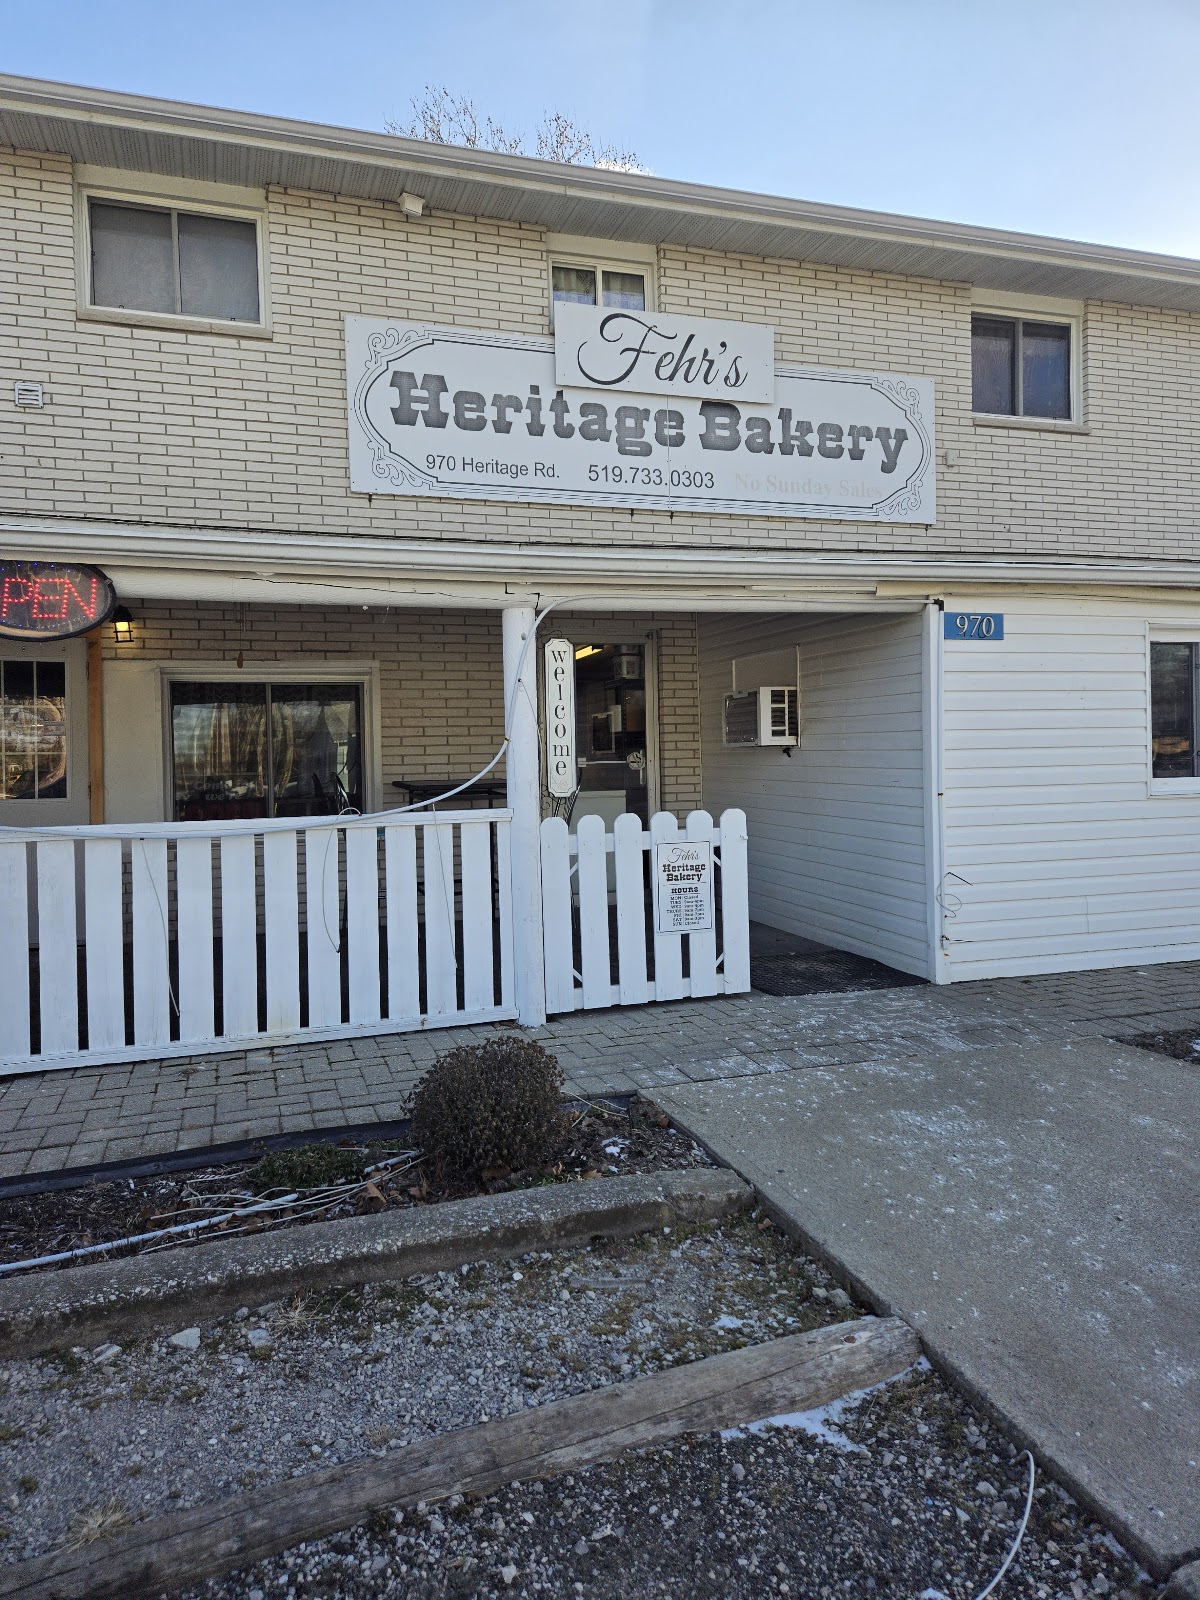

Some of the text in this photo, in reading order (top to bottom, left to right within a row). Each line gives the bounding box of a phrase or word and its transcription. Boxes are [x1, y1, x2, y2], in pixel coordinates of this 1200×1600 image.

[577, 313, 748, 388] Fehr's
[389, 370, 909, 474] Heritage Bakery
[426, 454, 715, 489] 970 Heritage Rd. 519.733.0303
[736, 472, 883, 499] No Sunday Sales
[956, 615, 995, 637] 970
[662, 863, 706, 872] Heritage
[666, 873, 703, 882] Bakery
